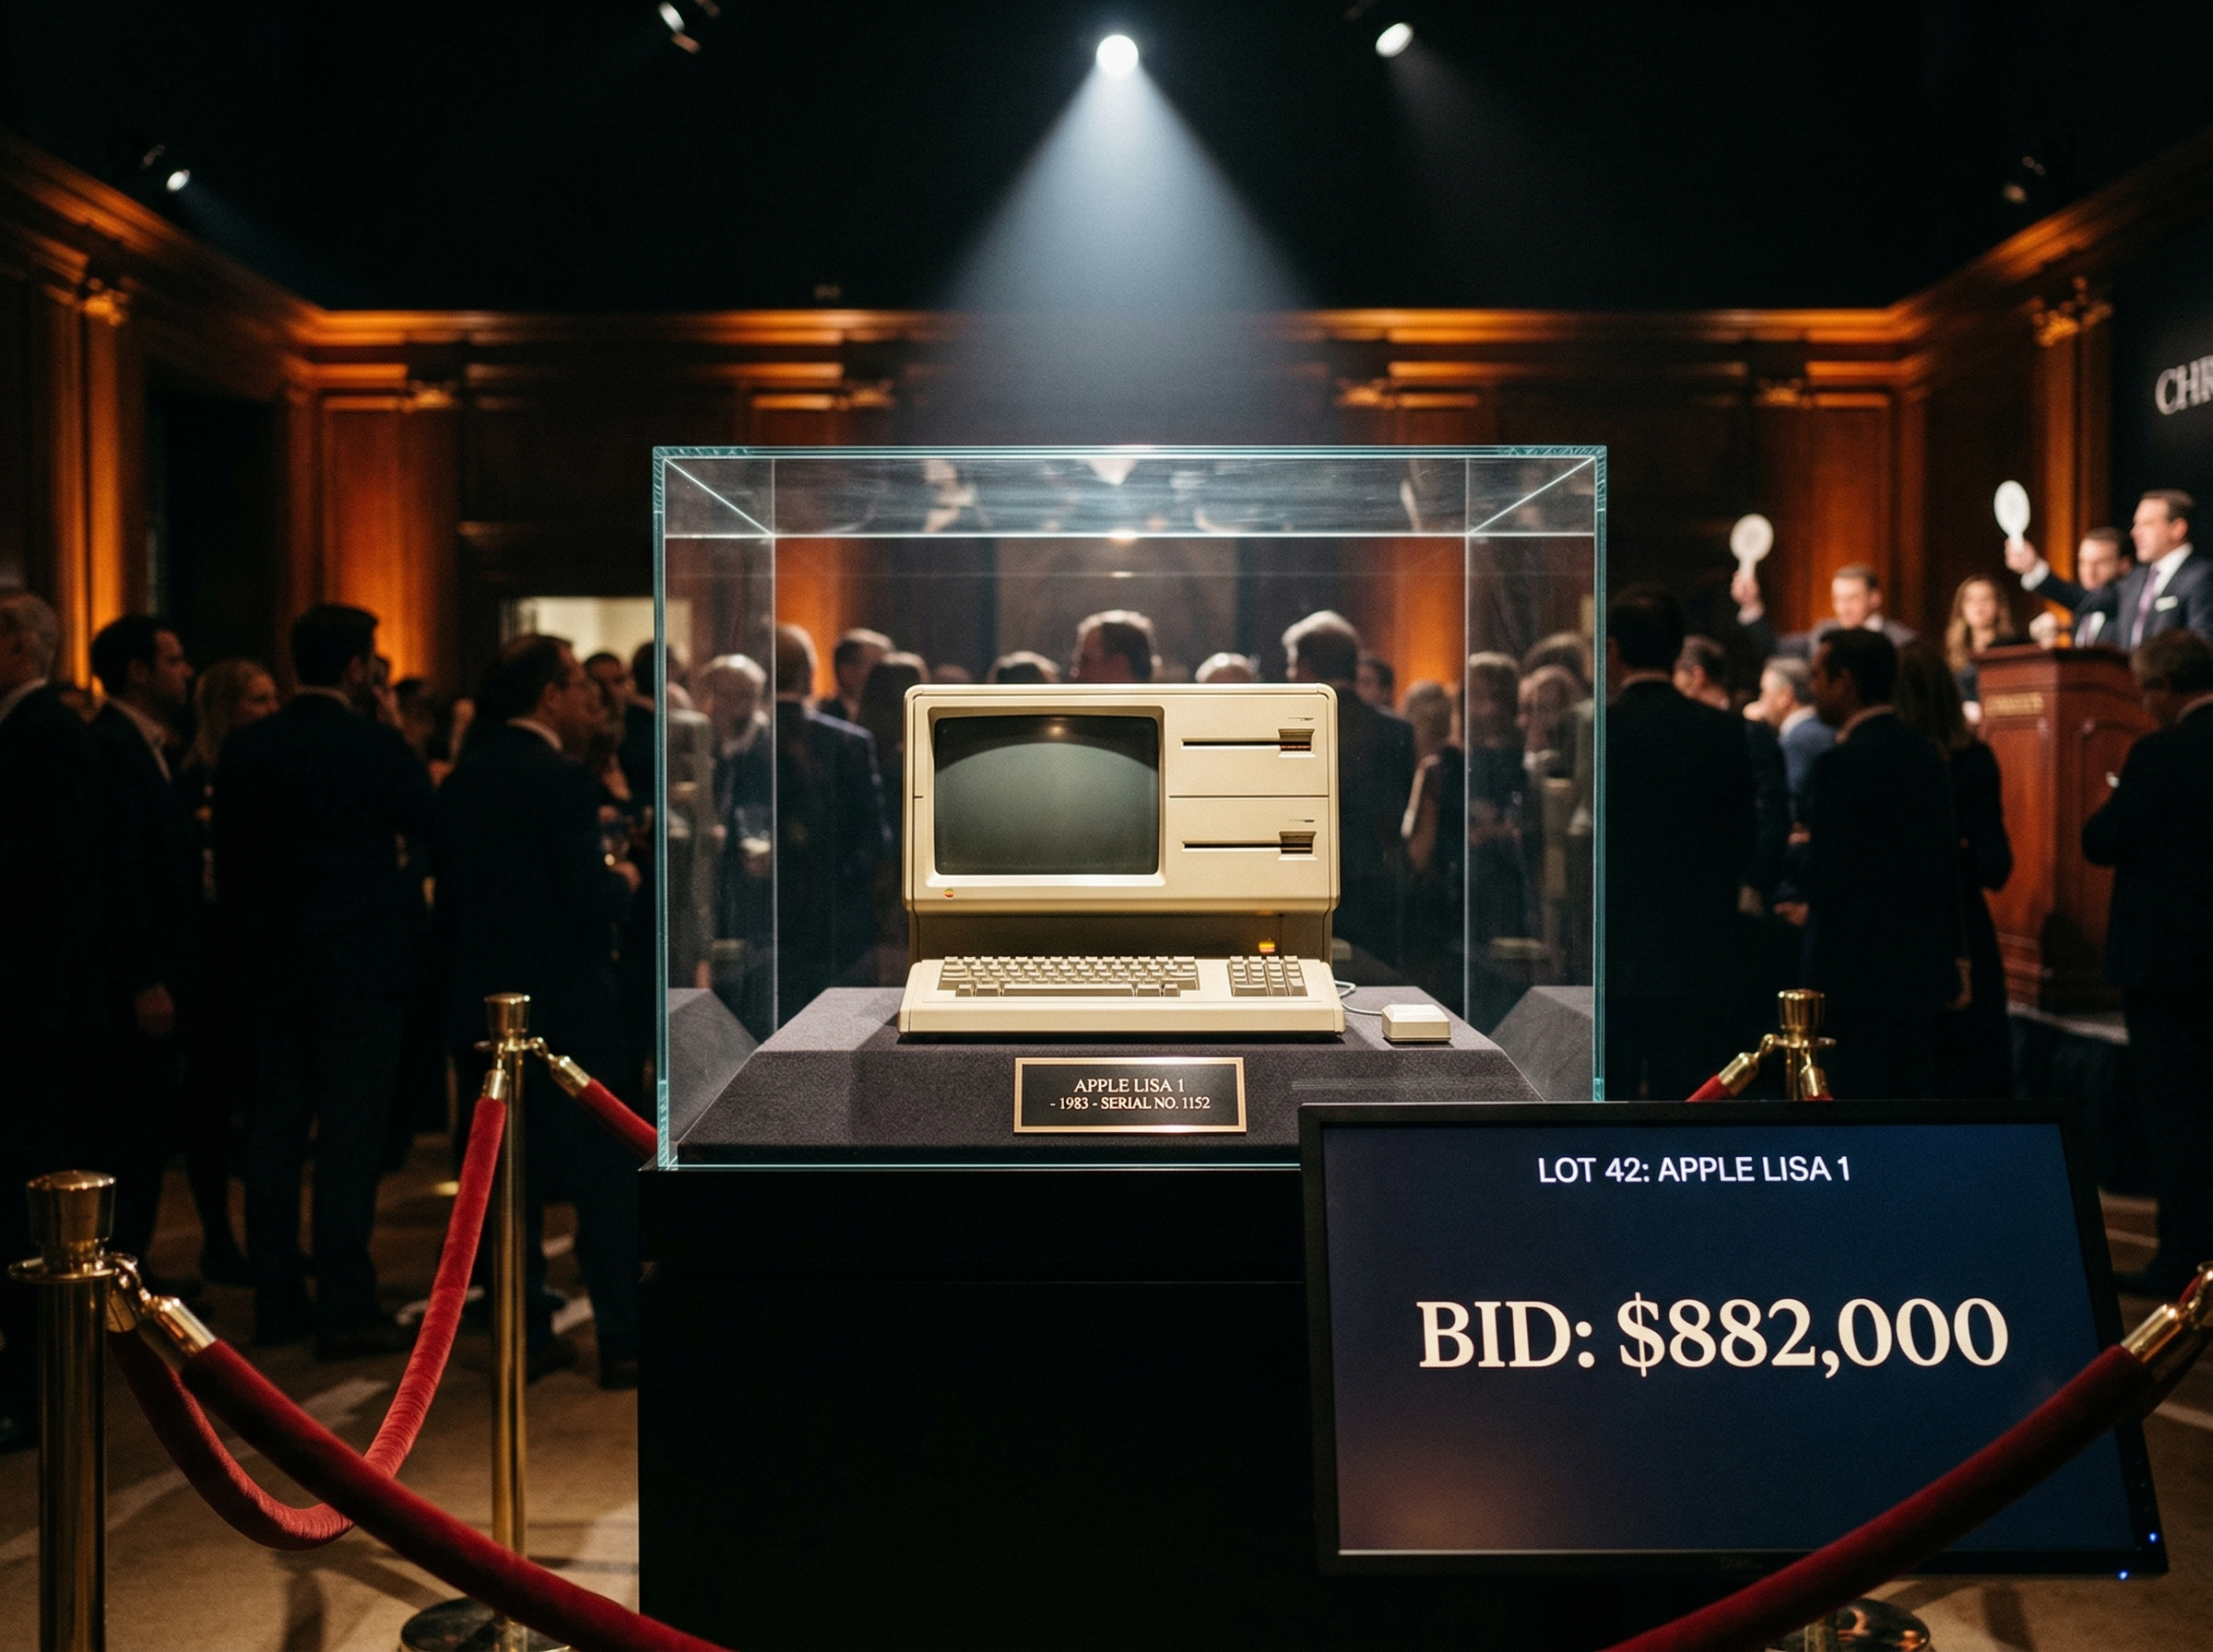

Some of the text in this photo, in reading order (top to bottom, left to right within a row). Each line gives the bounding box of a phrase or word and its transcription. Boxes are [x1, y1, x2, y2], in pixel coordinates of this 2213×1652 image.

[1073, 1078, 1185, 1093] APPLE LISA 1
[1059, 1097, 1089, 1110] 1983
[1100, 1096, 1152, 1110] SERIAL
[1154, 1096, 1179, 1110] NO.
[1182, 1096, 1212, 1110] 1152
[1538, 1155, 1850, 1184] LOT 42: APPLE LISA 1
[1415, 1292, 2009, 1380] BID: $882,000
